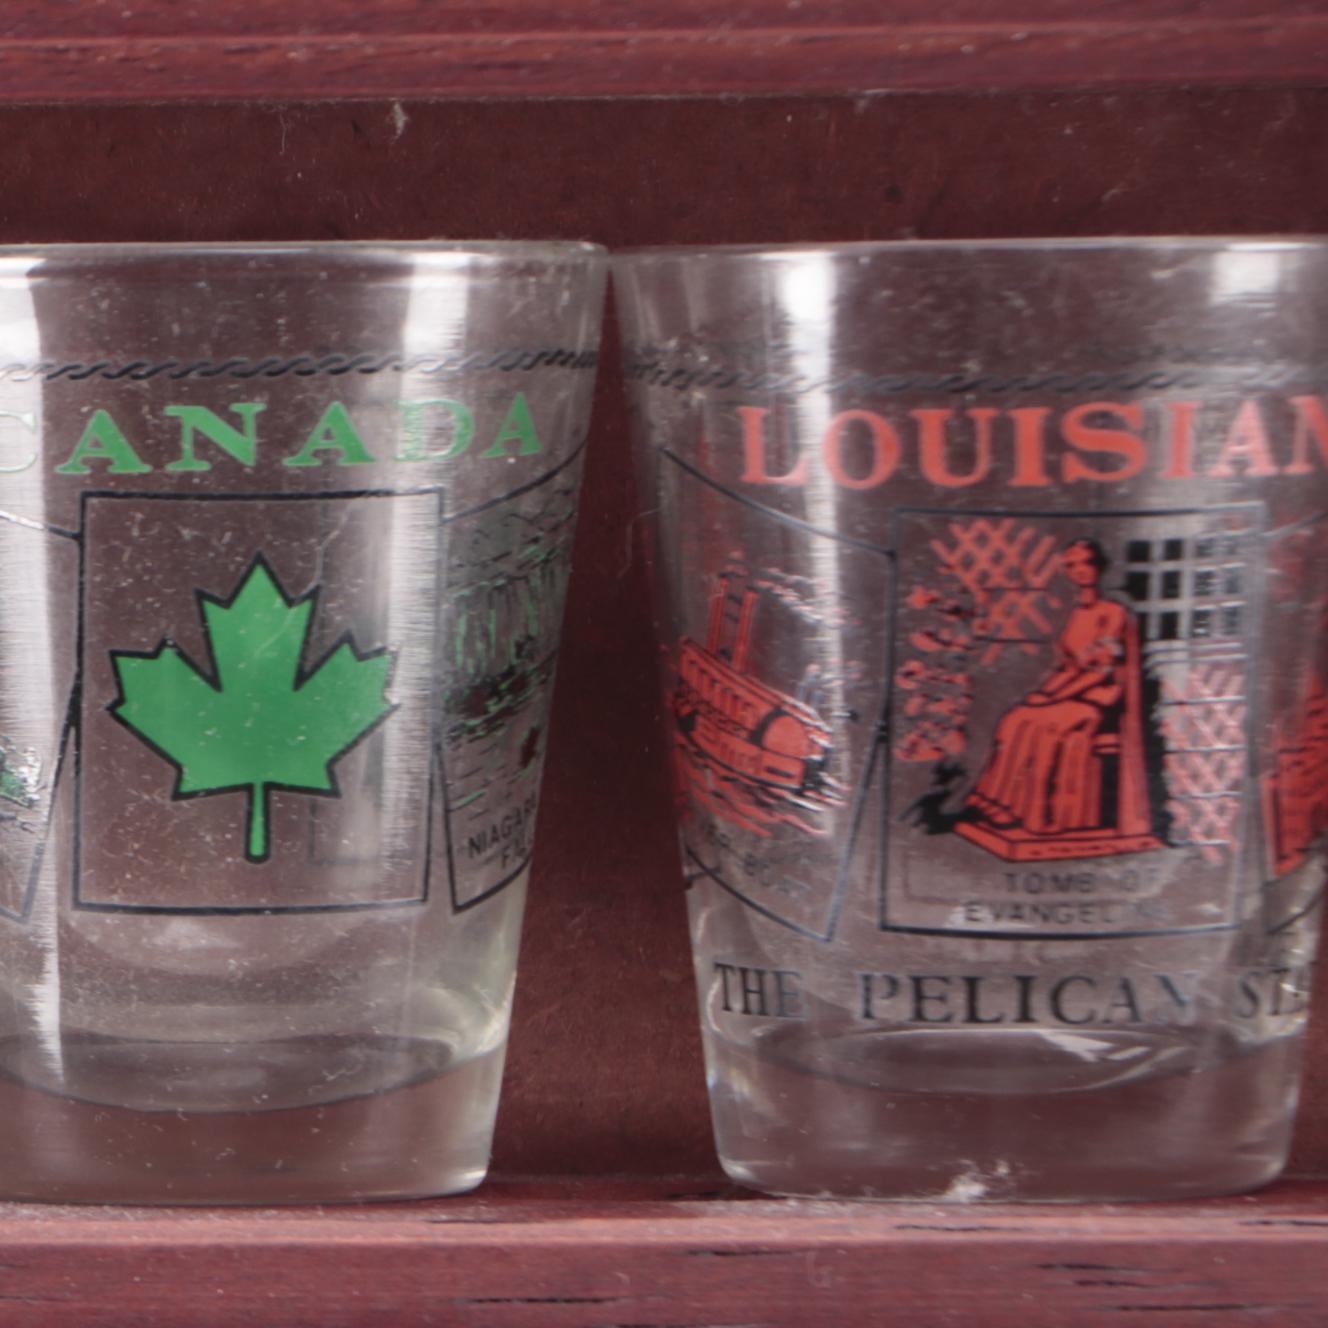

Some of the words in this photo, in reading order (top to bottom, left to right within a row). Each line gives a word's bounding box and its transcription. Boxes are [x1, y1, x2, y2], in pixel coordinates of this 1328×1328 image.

[1003, 871, 1098, 894] TOMB
[963, 900, 1171, 925] EVANGEL
[713, 961, 807, 1020] THE
[855, 971, 1201, 1026] PELICAN
